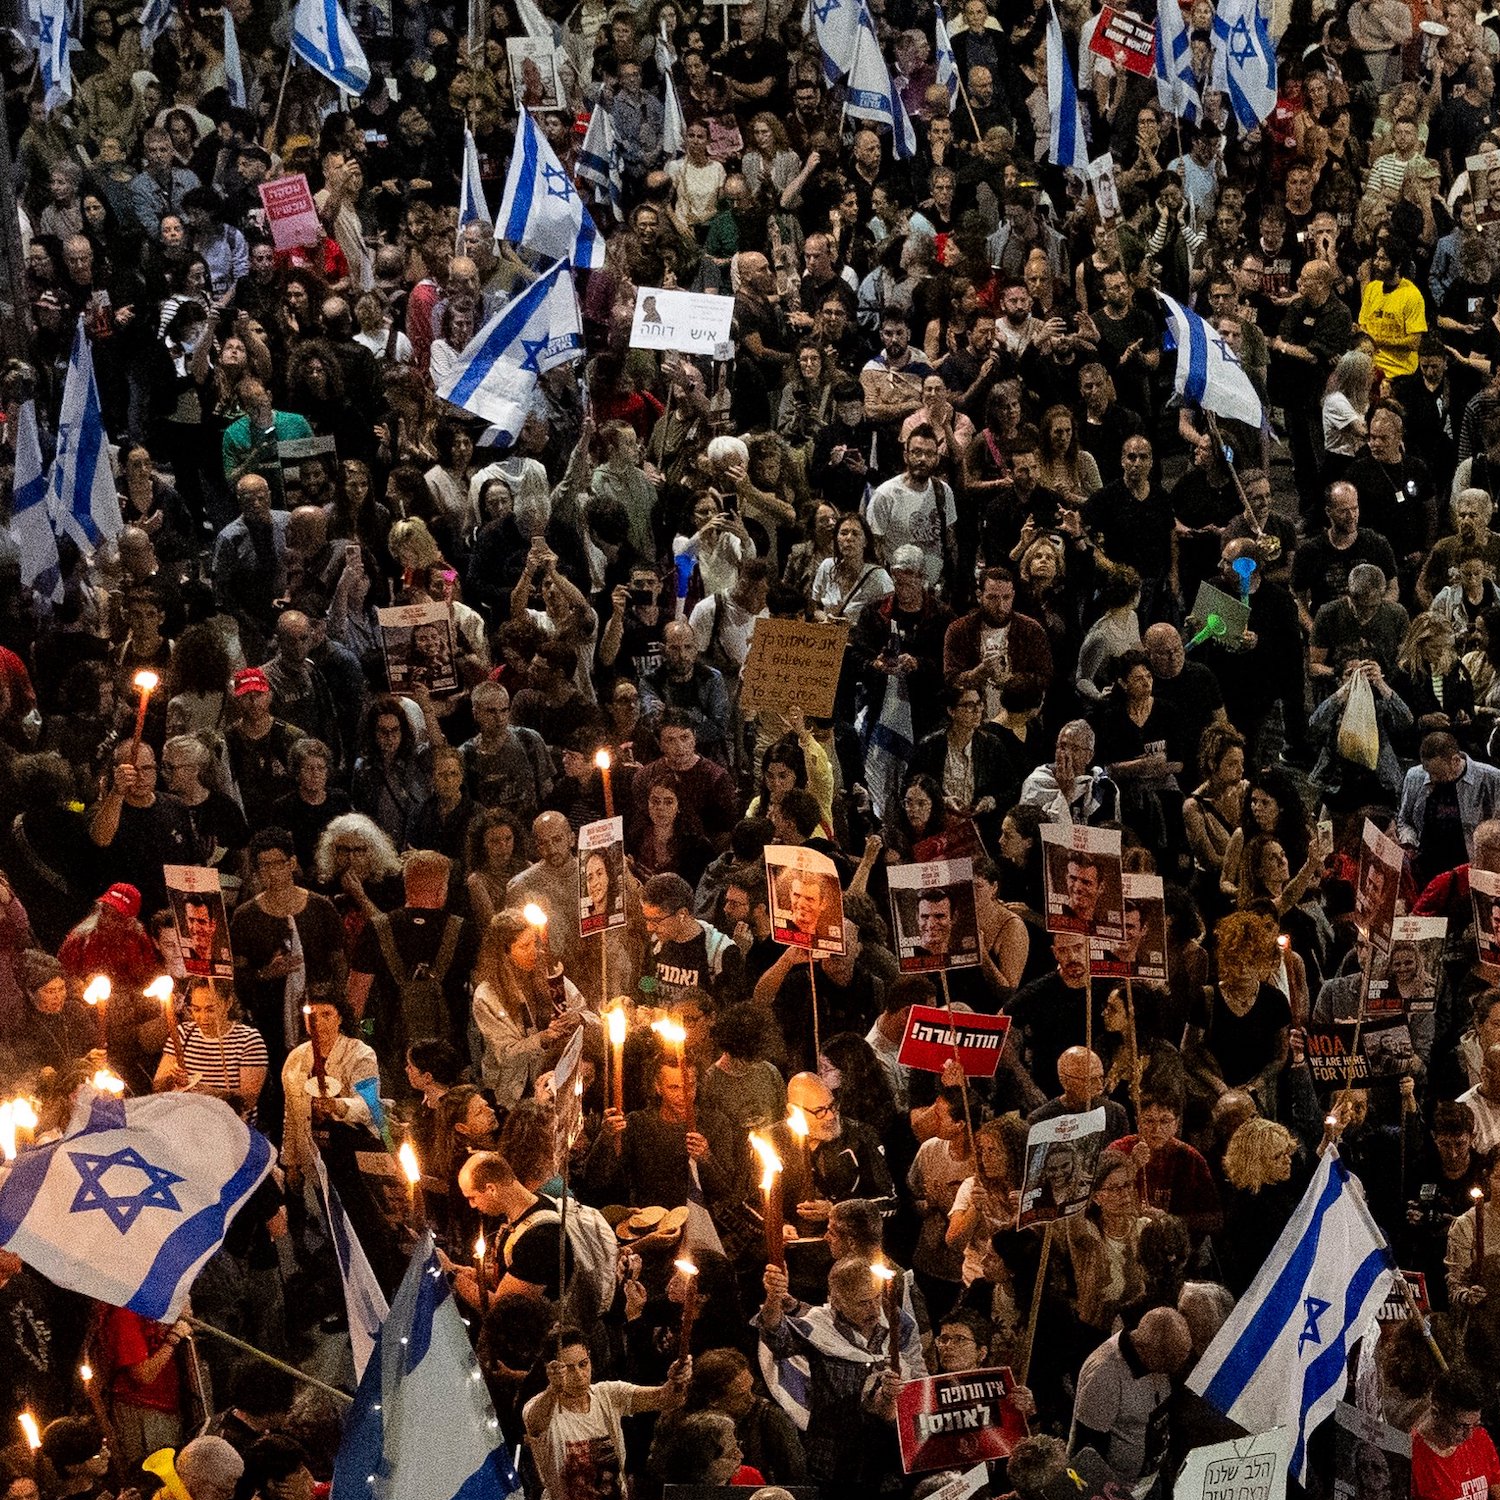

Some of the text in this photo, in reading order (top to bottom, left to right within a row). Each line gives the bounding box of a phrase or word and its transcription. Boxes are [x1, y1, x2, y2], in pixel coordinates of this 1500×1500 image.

[640, 323, 718, 342] איש דוחה
[911, 1022, 1000, 1049] תודה שרה!
[1307, 1035, 1346, 1056] NOA
[1309, 1056, 1324, 1068] WE
[1325, 1056, 1342, 1067] ARE
[1313, 1067, 1338, 1081] FOR
[940, 1380, 1005, 1406] אין תרופה
[919, 1403, 991, 1440] לאונס!
[1208, 1459, 1270, 1485] הלב שלנו
